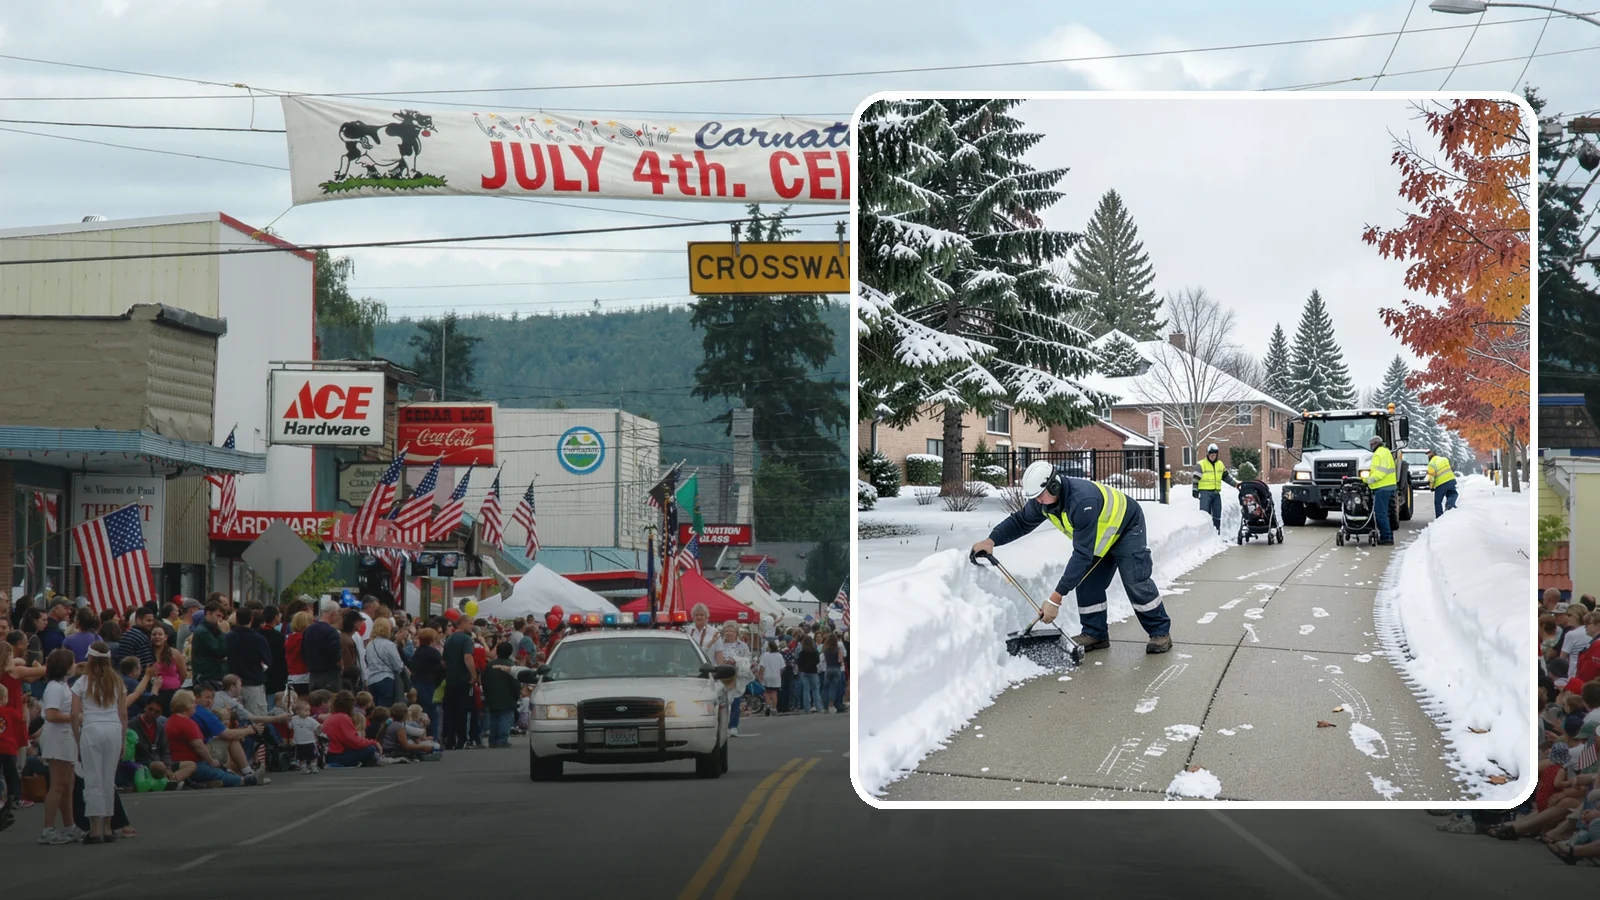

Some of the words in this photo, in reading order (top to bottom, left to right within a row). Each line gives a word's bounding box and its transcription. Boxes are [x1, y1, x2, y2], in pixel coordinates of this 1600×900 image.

[695, 121, 850, 149] Carnat
[481, 141, 605, 192] JULY
[632, 150, 746, 198] 4th.
[697, 254, 850, 280] CROSSWA
[283, 380, 373, 420] ACE
[405, 409, 452, 421] CEDAR
[461, 409, 485, 421] LOG
[283, 421, 371, 436] Hardware
[416, 428, 477, 447] Coca-Cola
[353, 467, 384, 479] Simpl
[83, 484, 94, 494] St.
[95, 484, 124, 495] Vincent
[126, 485, 136, 495] de
[137, 485, 155, 495] Paul
[80, 503, 154, 522] THT
[688, 526, 741, 535] CRNATION
[699, 535, 730, 543] GLASS
